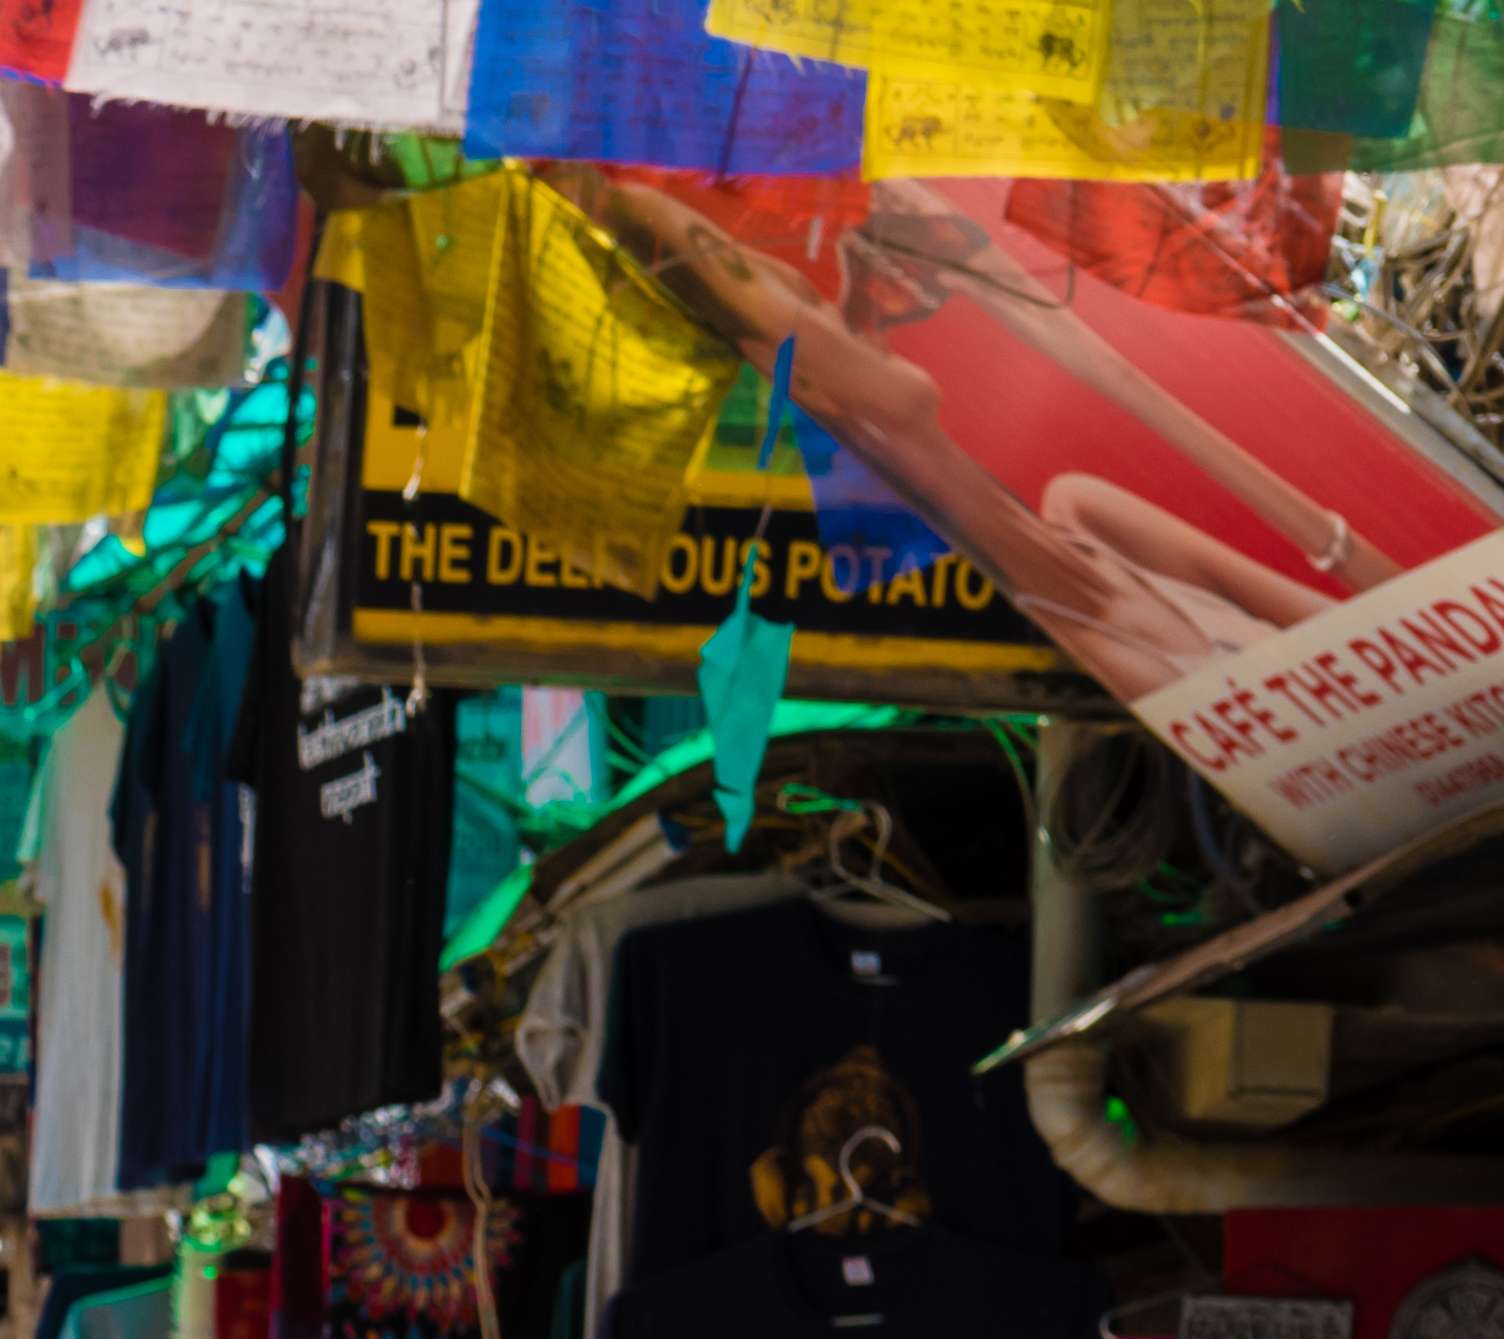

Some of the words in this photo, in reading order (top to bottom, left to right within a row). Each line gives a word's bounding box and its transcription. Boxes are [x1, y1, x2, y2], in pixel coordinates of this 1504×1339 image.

[366, 519, 475, 584] THE
[1170, 675, 1301, 773] CAFÉ
[1264, 653, 1384, 729] THE
